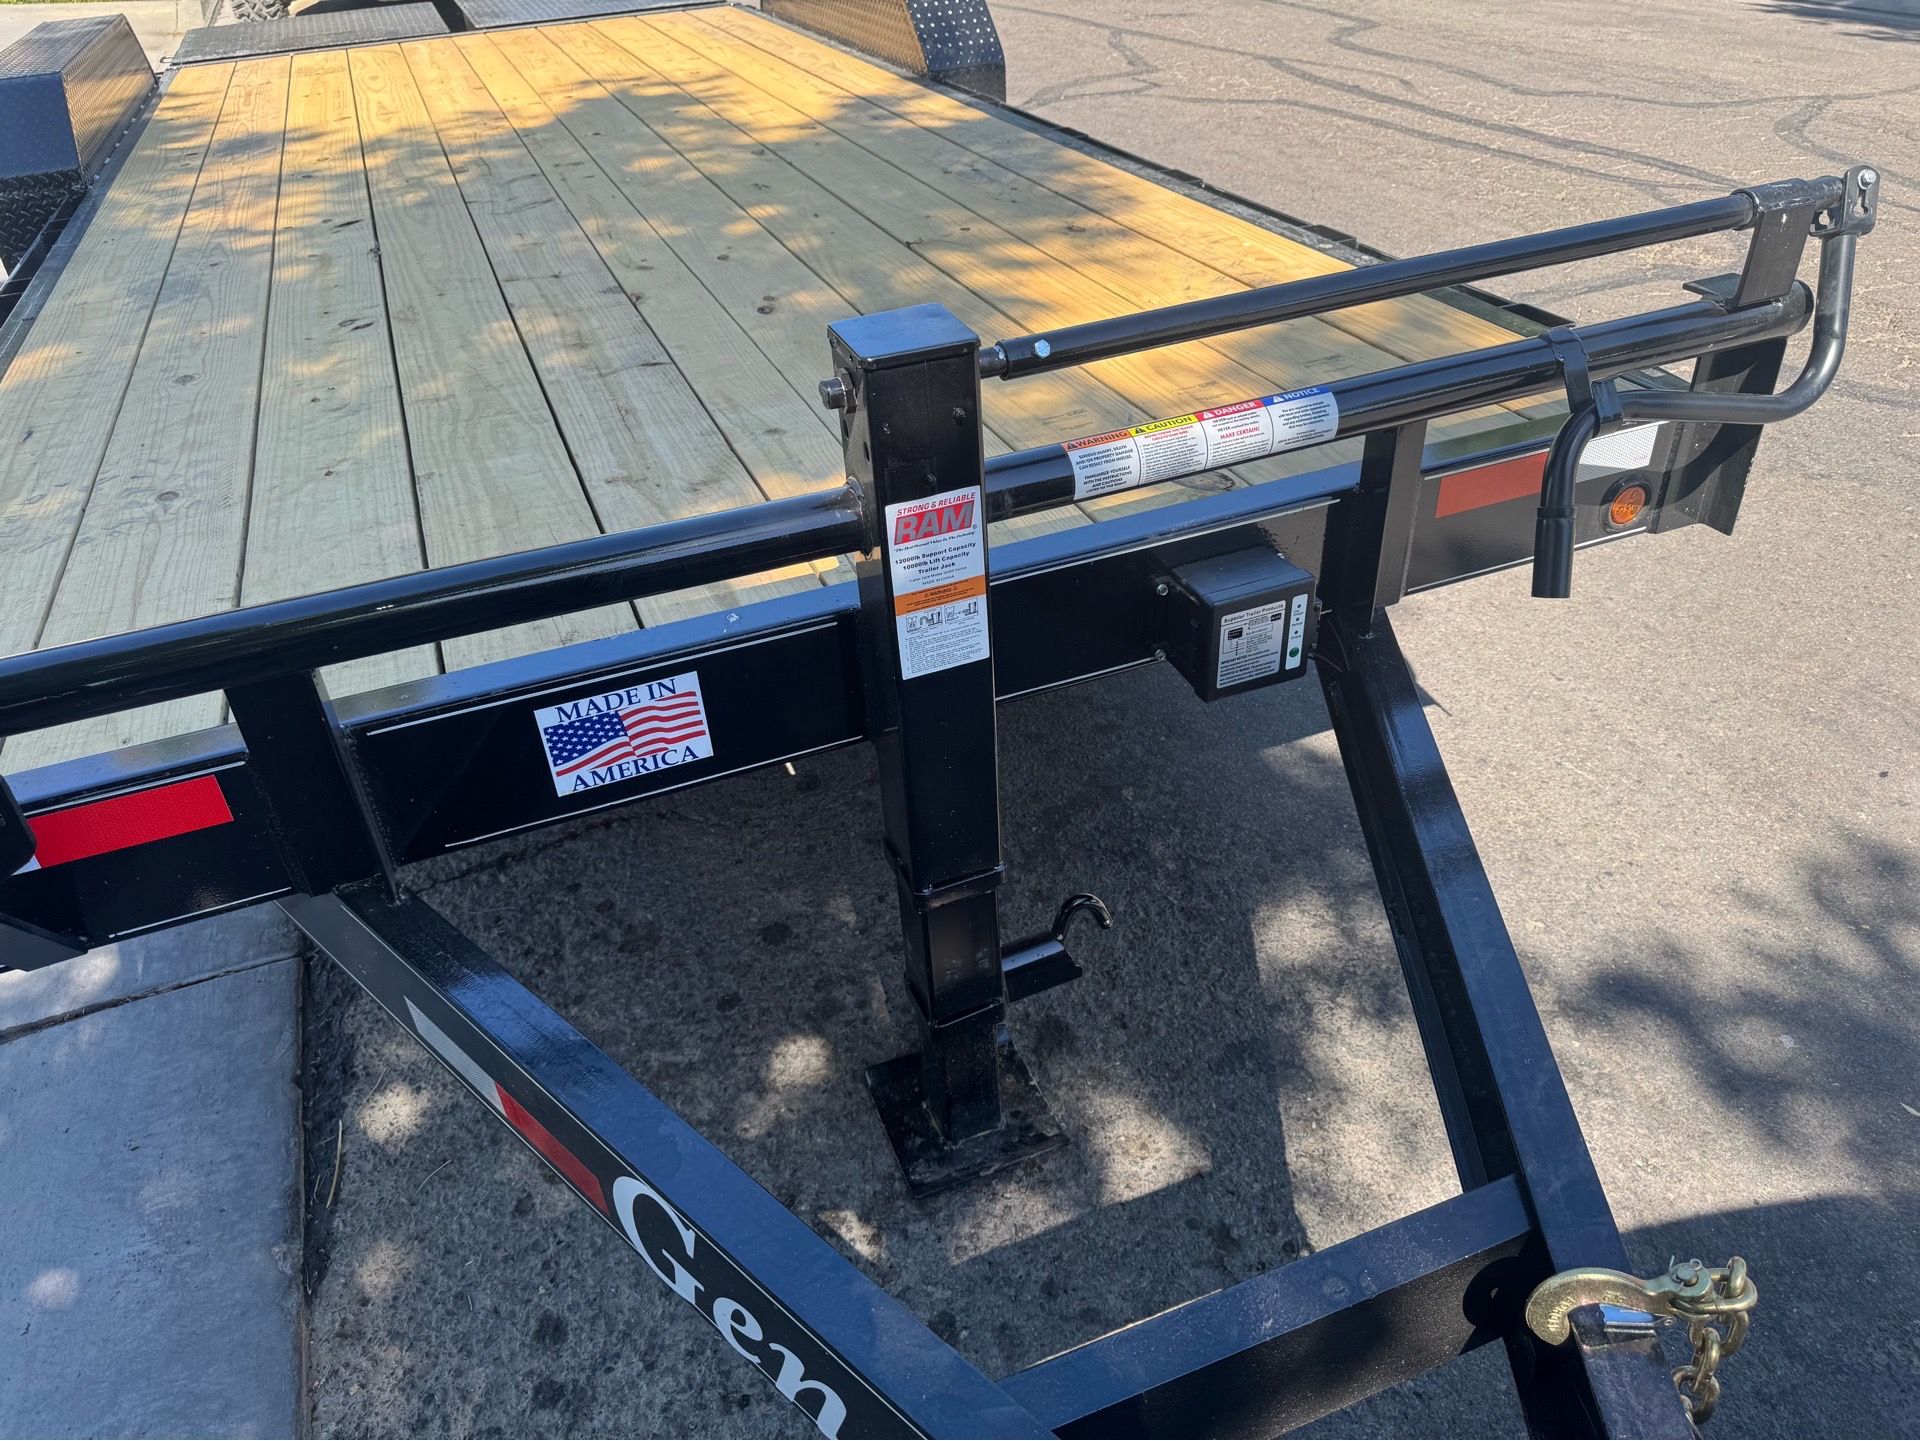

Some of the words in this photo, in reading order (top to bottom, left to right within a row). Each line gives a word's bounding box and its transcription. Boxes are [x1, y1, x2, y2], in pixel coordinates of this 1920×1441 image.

[1283, 387, 1320, 400] NOTICE
[1215, 402, 1257, 415] DANGER
[1146, 416, 1193, 430] CAUTION
[1236, 425, 1259, 436] CERTAIN!
[1076, 431, 1127, 446] WARNING
[1094, 453, 1114, 461] PROPERTY
[1102, 478, 1122, 486] CAUTIONS
[1103, 471, 1131, 480] INSTRUCTIONS
[897, 503, 929, 516] STRONG
[938, 492, 976, 506] RELIABLE
[896, 503, 974, 543] RAM
[895, 555, 919, 564] 12000lb
[921, 549, 946, 559] Support
[948, 542, 975, 552] Capacity
[903, 561, 927, 570] 10000lb
[941, 551, 969, 561] Capacity
[929, 587, 951, 596] WARNING
[1262, 604, 1283, 612] Products
[555, 688, 641, 723] MADE
[649, 678, 678, 700] IN
[572, 745, 699, 792] AMERICA
[612, 1176, 846, 1441] Gen
